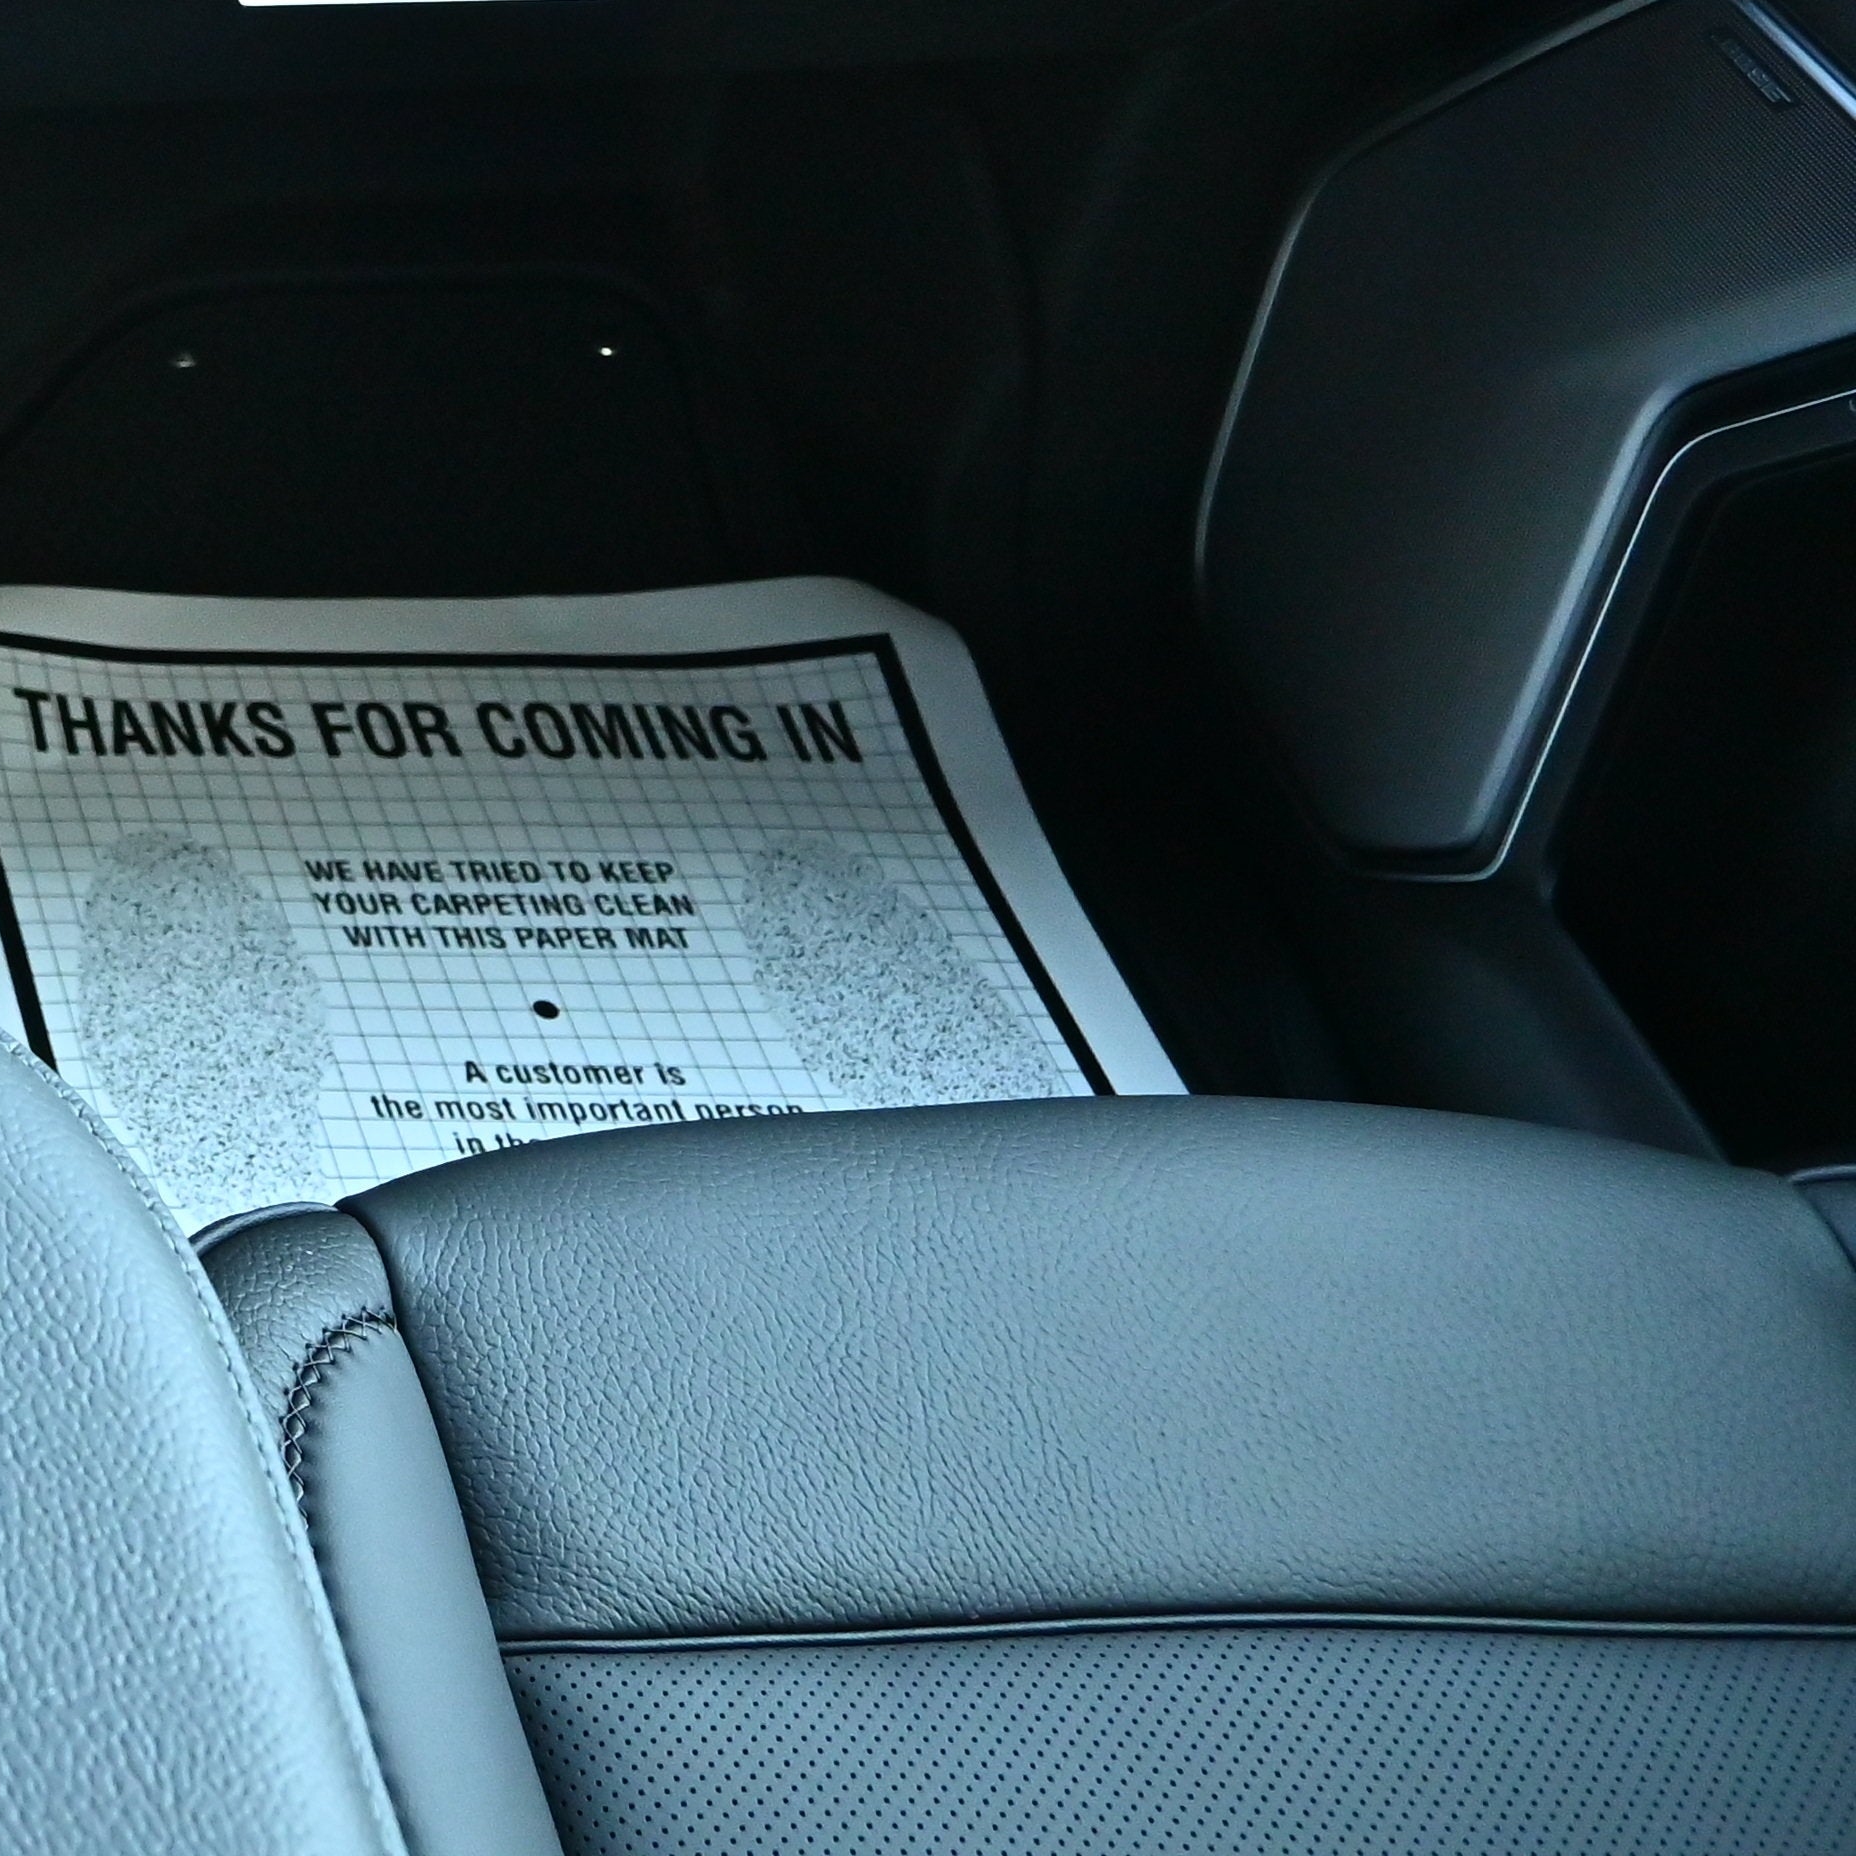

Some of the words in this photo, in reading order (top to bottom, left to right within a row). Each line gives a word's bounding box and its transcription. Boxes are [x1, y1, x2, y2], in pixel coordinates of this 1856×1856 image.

[13, 687, 296, 759] THANKS
[310, 701, 463, 759] FOR
[475, 700, 768, 762] COMING
[776, 700, 863, 763] IN
[304, 859, 356, 883] WE
[362, 859, 446, 884] HAVE
[450, 860, 543, 884] TRIED
[549, 860, 591, 884] TO
[599, 860, 676, 885] KEEP
[313, 892, 404, 915] YOUR
[412, 892, 587, 917] CARPETING
[594, 893, 696, 917] CLEAN
[343, 925, 426, 949] WITH
[432, 926, 508, 950] THIS
[515, 927, 618, 950] PAPER
[624, 927, 690, 951] MAT
[464, 1060, 487, 1083] A
[496, 1061, 644, 1086] customer
[655, 1061, 686, 1086] is
[371, 1094, 424, 1120] the
[435, 1096, 523, 1121] most
[524, 1096, 687, 1126] important
[453, 1131, 486, 1154] in
